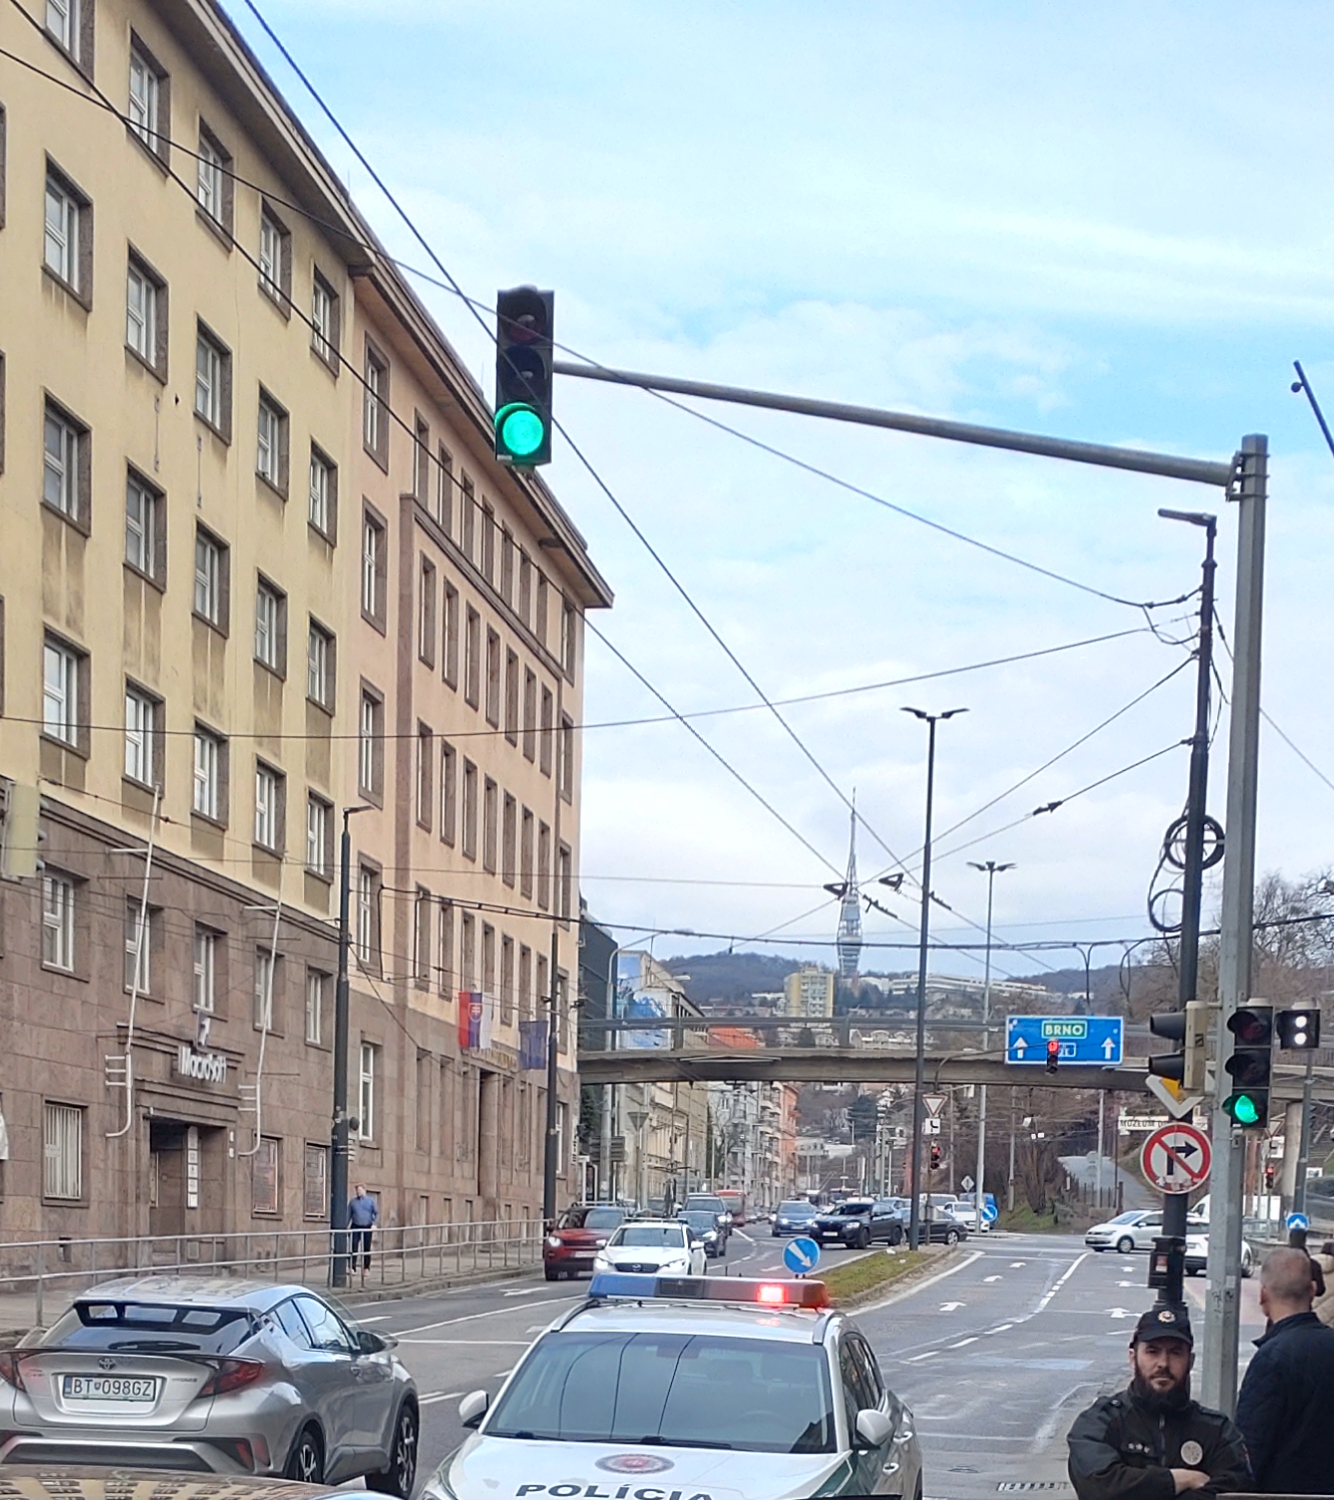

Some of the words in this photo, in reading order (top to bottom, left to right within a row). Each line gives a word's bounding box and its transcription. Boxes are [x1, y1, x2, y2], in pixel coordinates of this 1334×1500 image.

[1045, 1024, 1083, 1036] BRNO
[73, 1377, 92, 1395] BT
[102, 1378, 152, 1397] 098GZ
